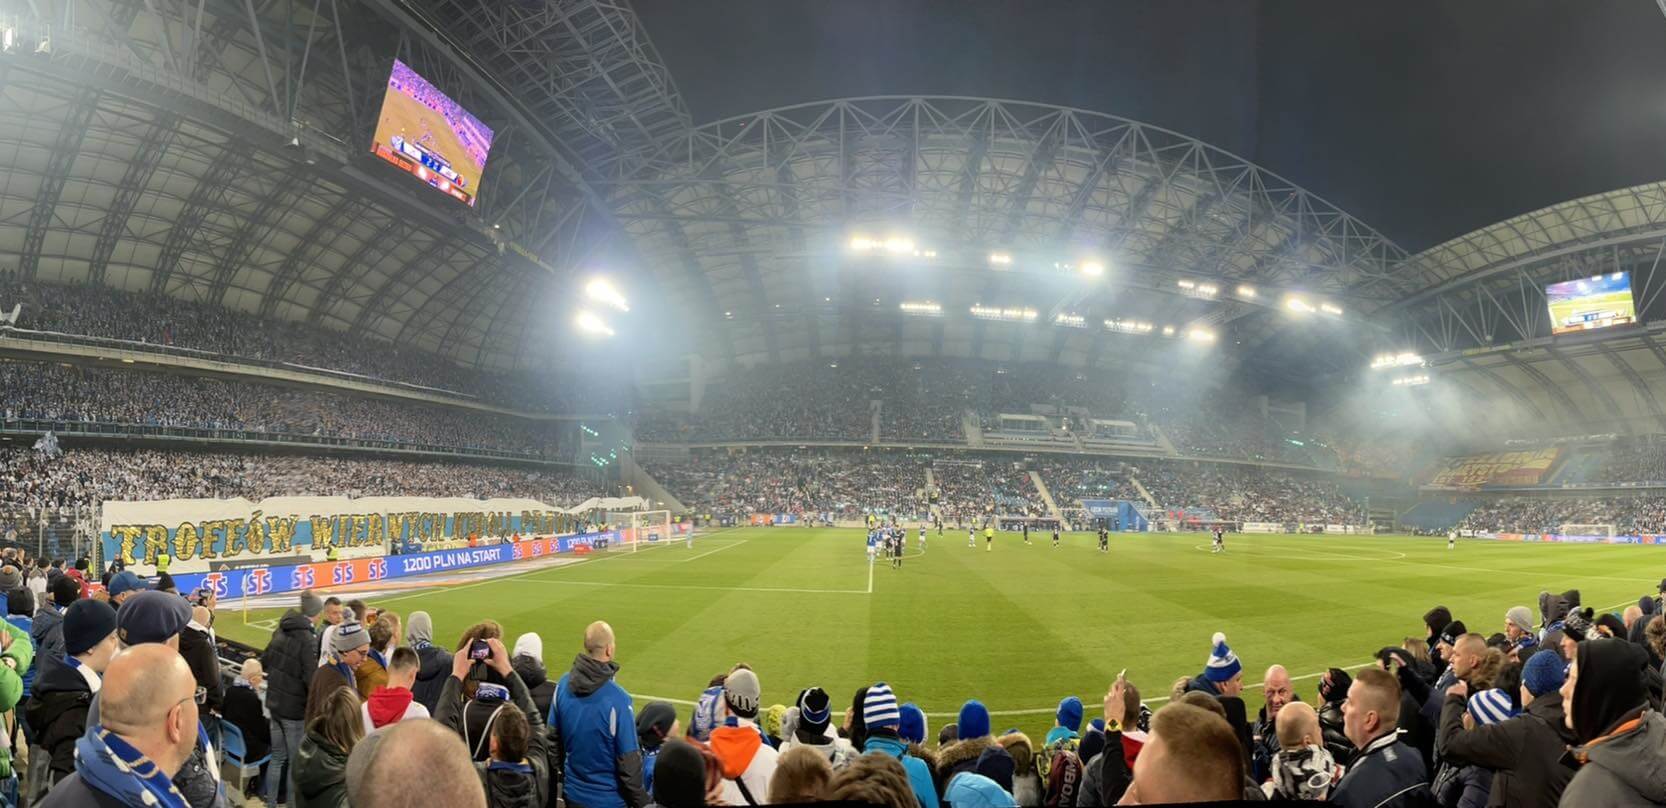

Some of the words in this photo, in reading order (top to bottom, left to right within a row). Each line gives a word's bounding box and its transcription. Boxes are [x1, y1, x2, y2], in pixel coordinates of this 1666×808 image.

[111, 510, 299, 565] TROFEÓW
[310, 511, 447, 550] WIERNYCH
[368, 558, 388, 579] STS
[403, 557, 431, 572] 1200
[434, 554, 455, 568] PLN
[457, 551, 472, 565] NA
[472, 548, 501, 563] START
[247, 568, 273, 595] STS
[292, 565, 315, 588] STS
[333, 562, 353, 583] STS
[201, 572, 227, 598] STS
